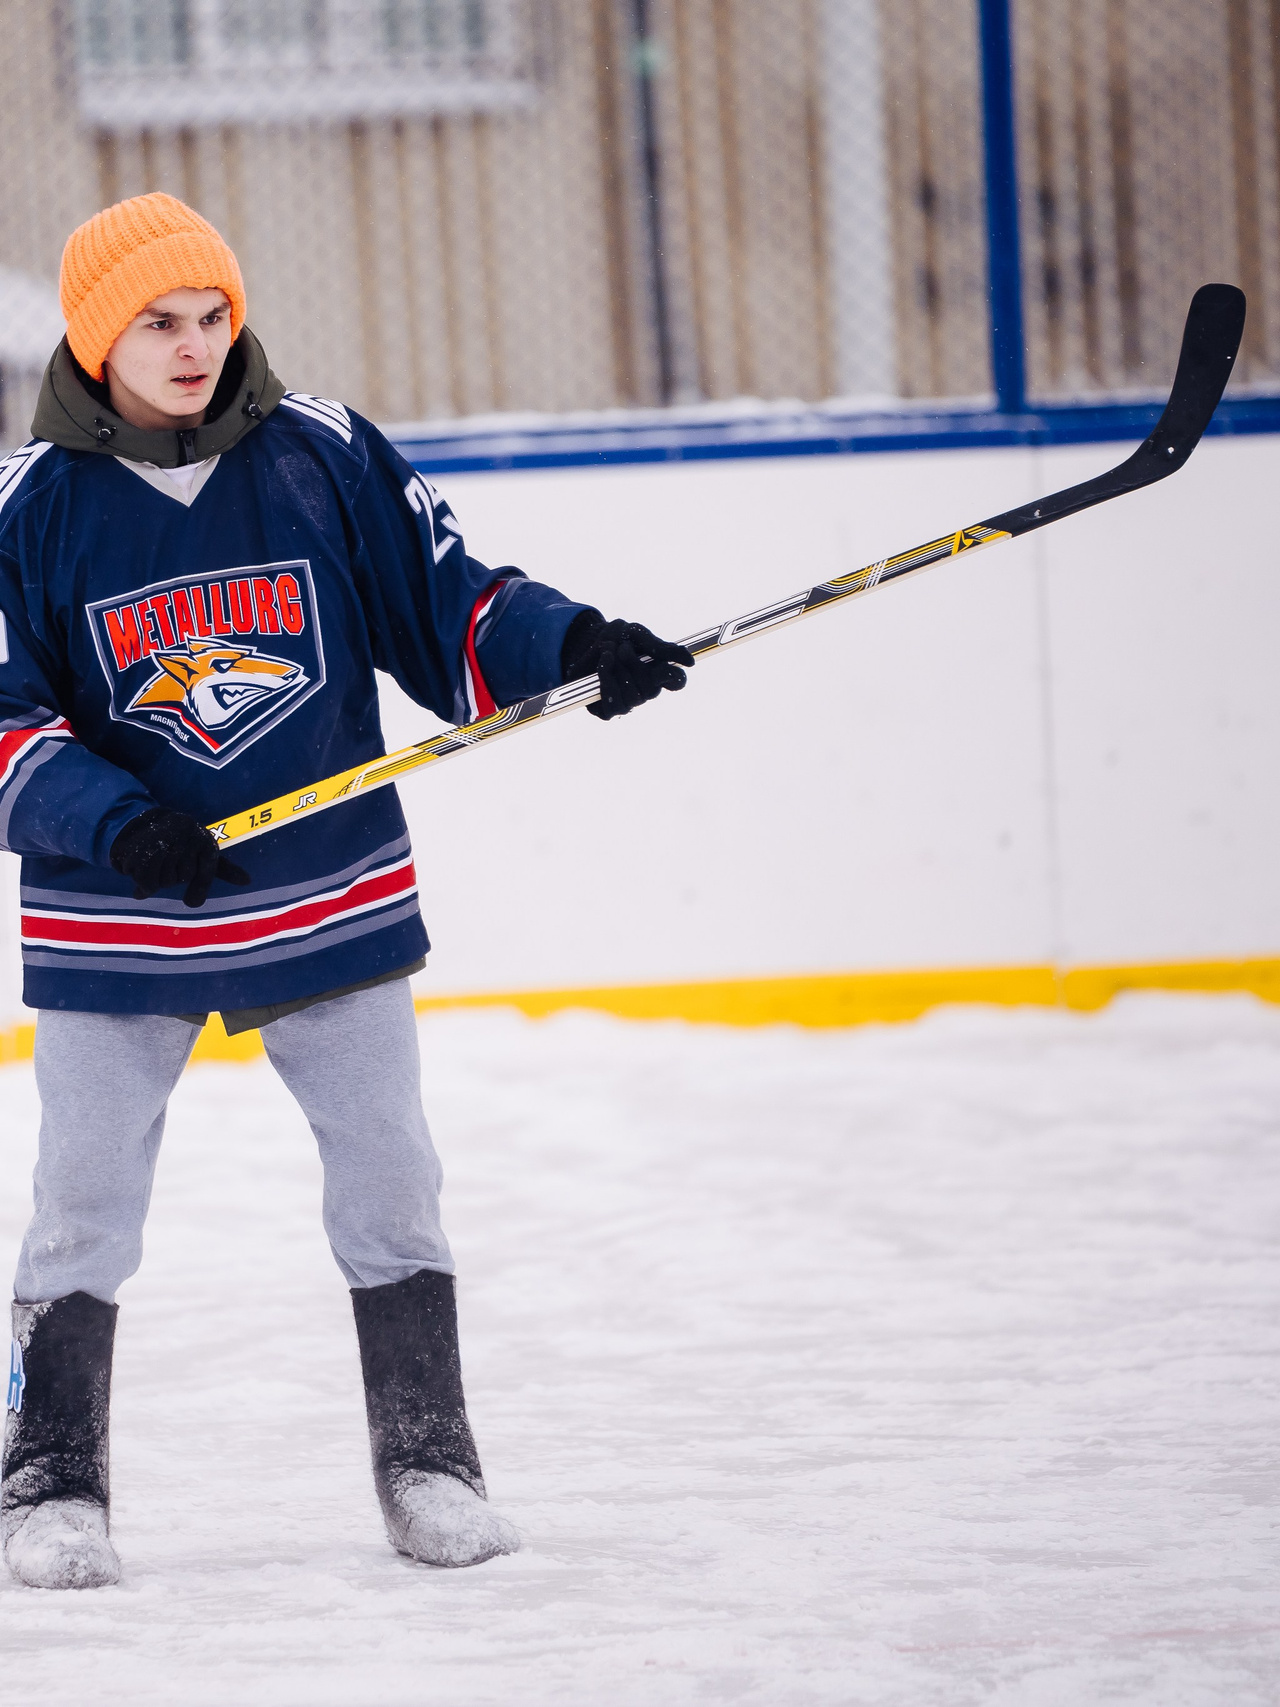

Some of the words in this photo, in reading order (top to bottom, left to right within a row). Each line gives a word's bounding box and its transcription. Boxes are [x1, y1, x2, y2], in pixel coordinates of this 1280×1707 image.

[103, 573, 306, 672] METALLURG
[249, 808, 272, 828] 1.5
[293, 791, 317, 812] JR
